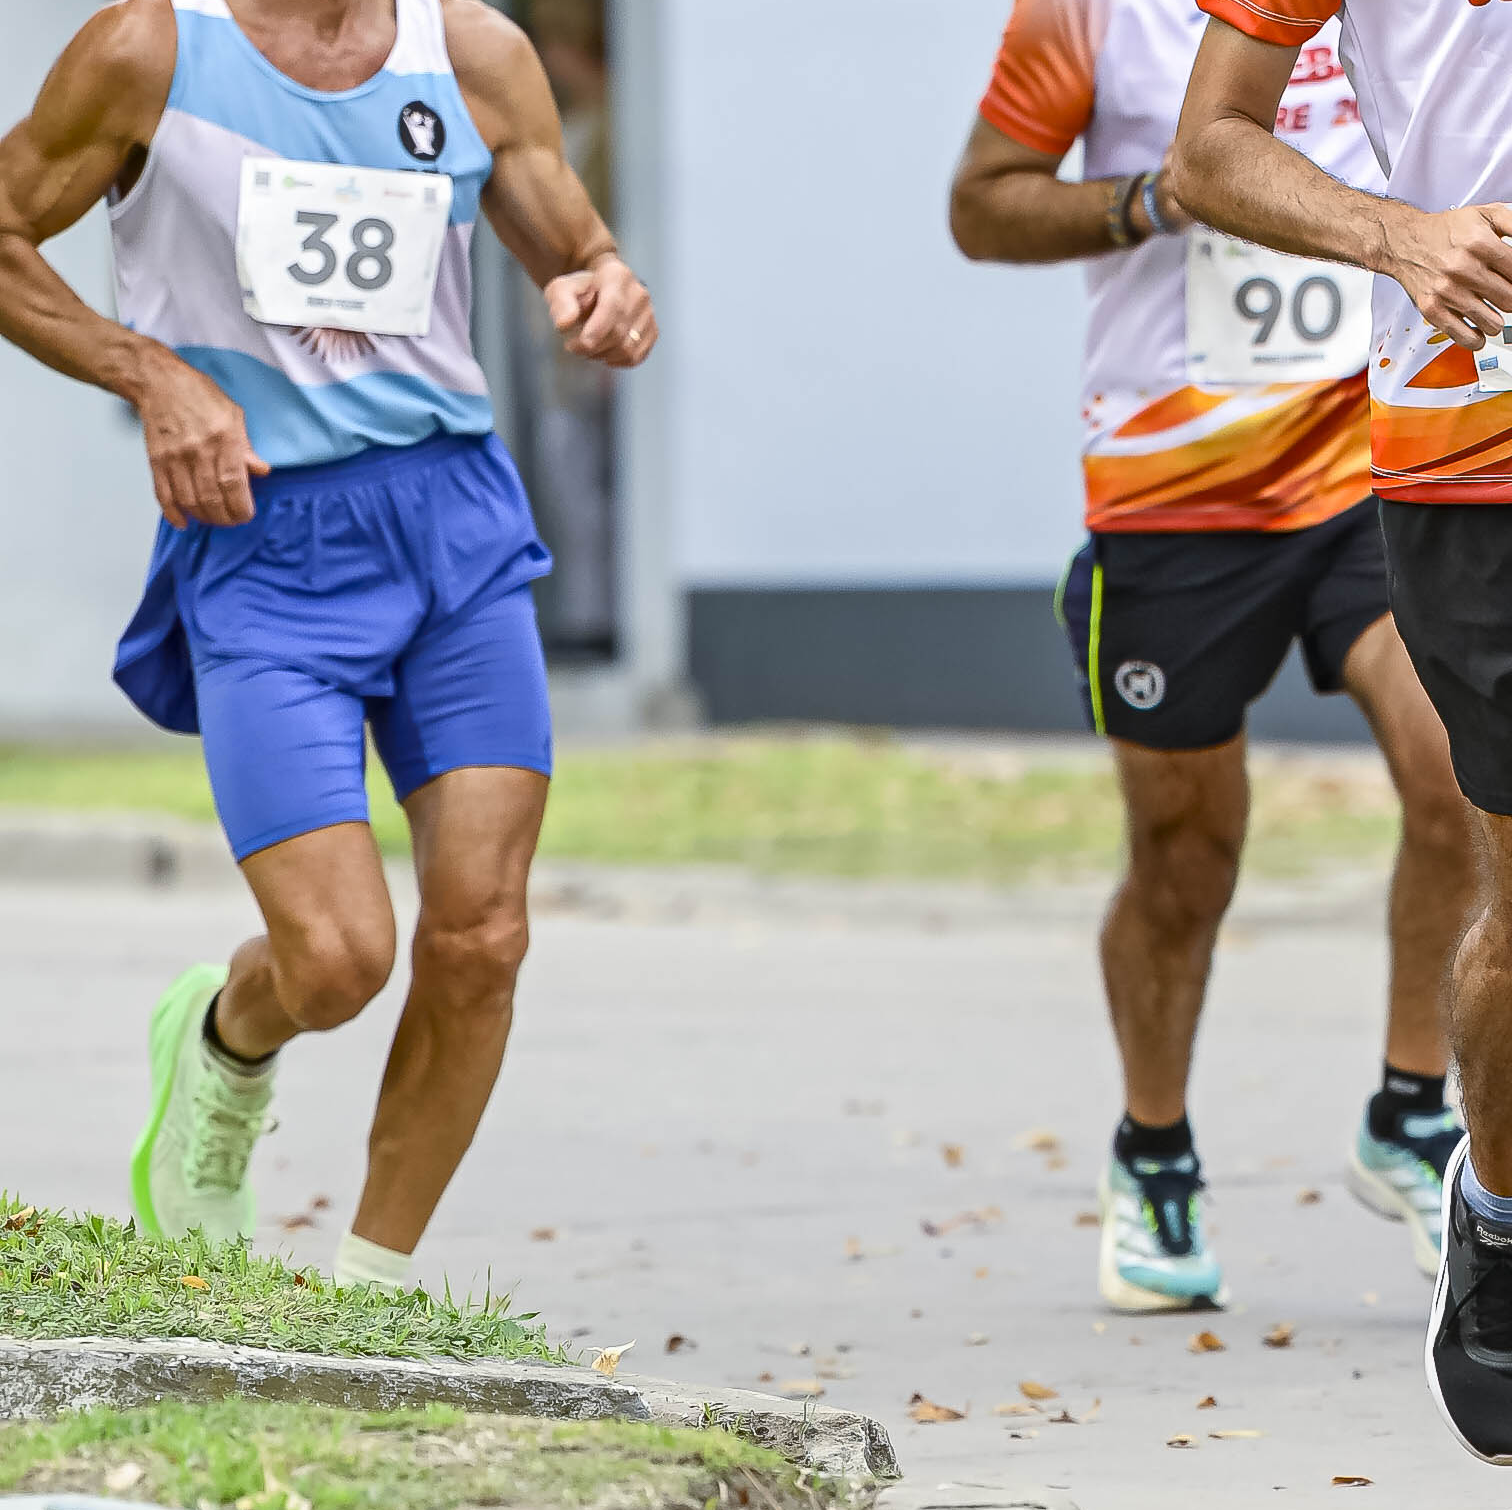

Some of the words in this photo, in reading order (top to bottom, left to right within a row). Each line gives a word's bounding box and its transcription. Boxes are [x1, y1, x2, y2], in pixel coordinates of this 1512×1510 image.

[287, 210, 394, 290] 38
[1235, 276, 1342, 344] 90
[1476, 1225, 1512, 1244] Reebok
